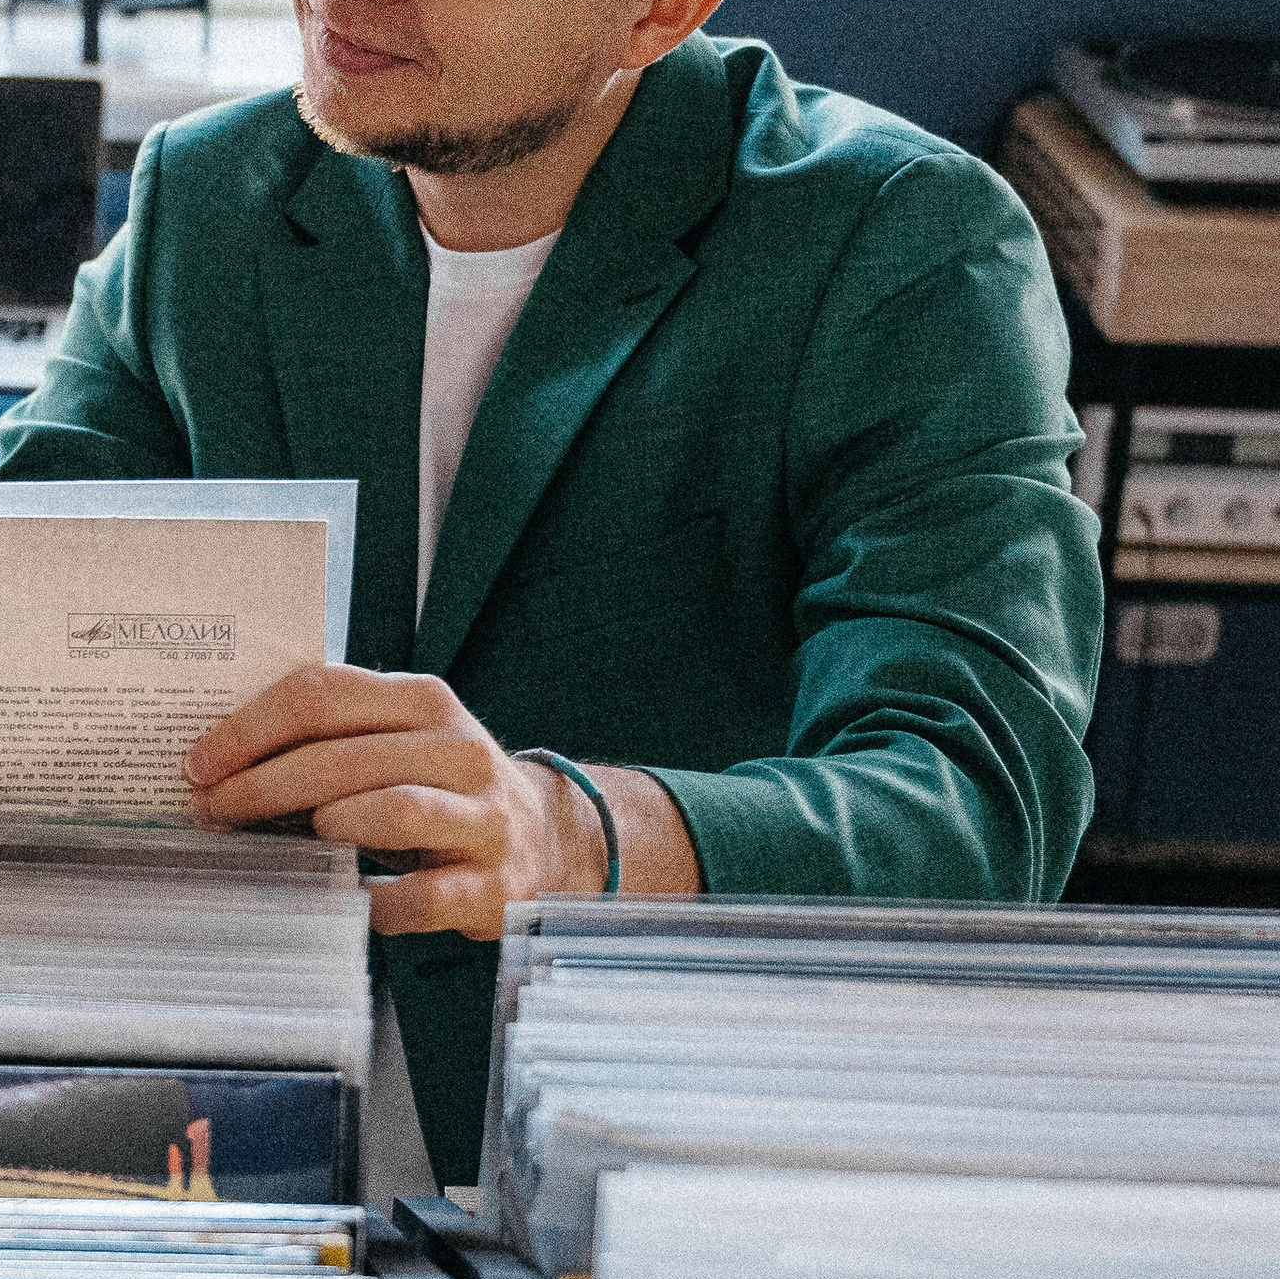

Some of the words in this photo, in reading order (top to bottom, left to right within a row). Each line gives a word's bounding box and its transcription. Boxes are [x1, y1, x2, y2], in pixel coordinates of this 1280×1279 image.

[119, 623, 231, 640] МЕЛОДИЯ
[69, 651, 110, 659] СТЕРЕО
[217, 652, 235, 661] 002
[154, 686, 194, 694] исканий
[15, 711, 38, 719] ярко
[131, 711, 162, 719] порой
[154, 725, 200, 733] широтой
[103, 759, 177, 768] особенностью
